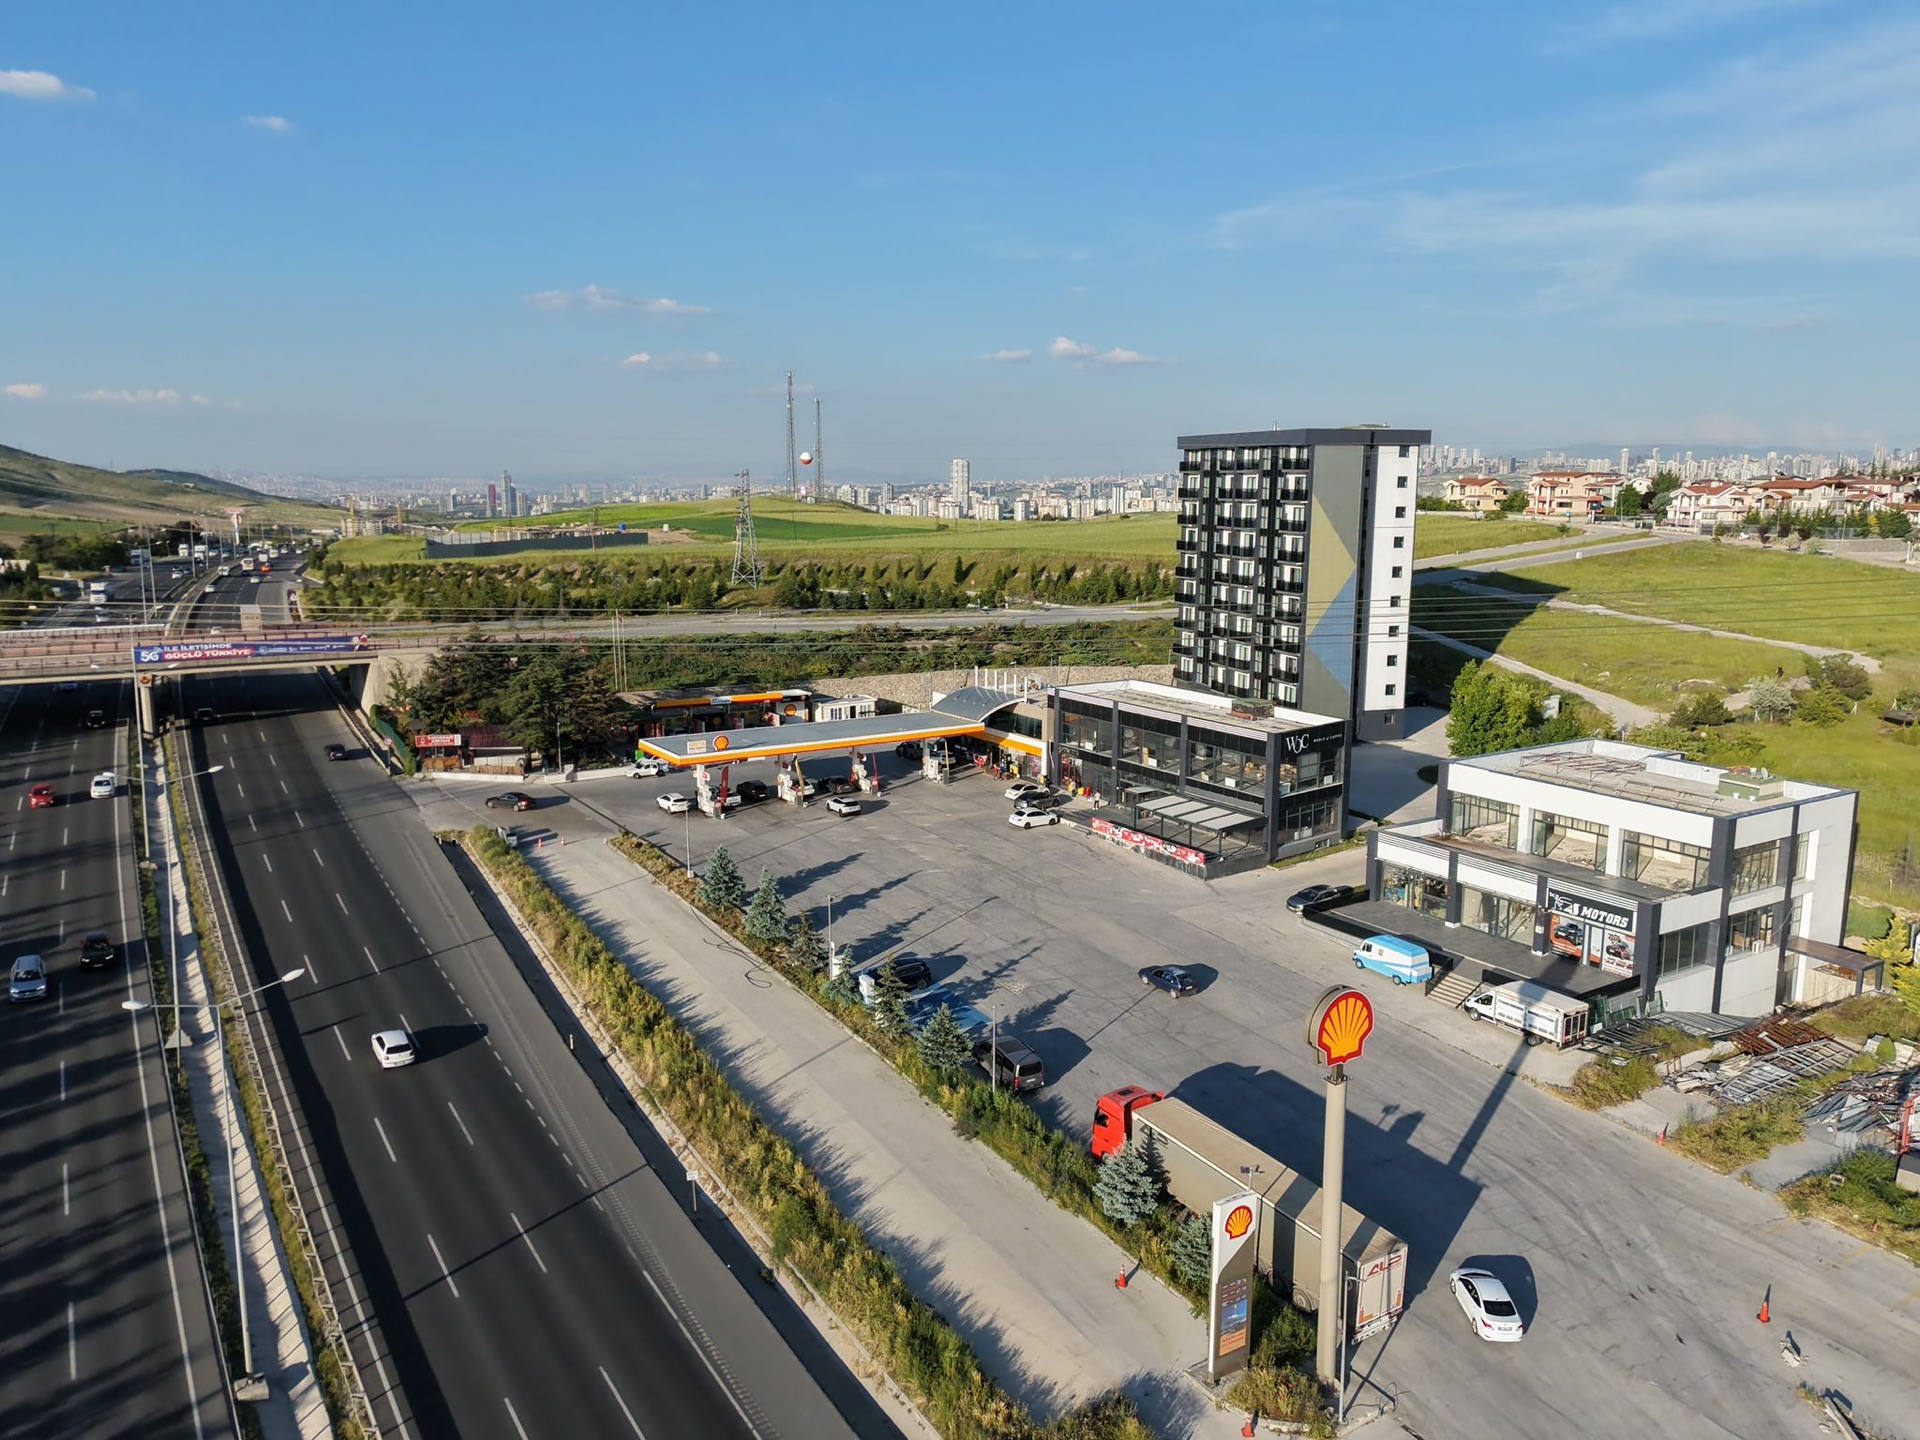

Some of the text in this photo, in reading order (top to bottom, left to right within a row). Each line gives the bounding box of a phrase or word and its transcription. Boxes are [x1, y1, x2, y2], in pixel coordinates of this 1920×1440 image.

[140, 651, 159, 662] 5G
[164, 649, 250, 659] GÜÇLÜ TÜRKİYE
[1581, 906, 1629, 928] MOTORS
